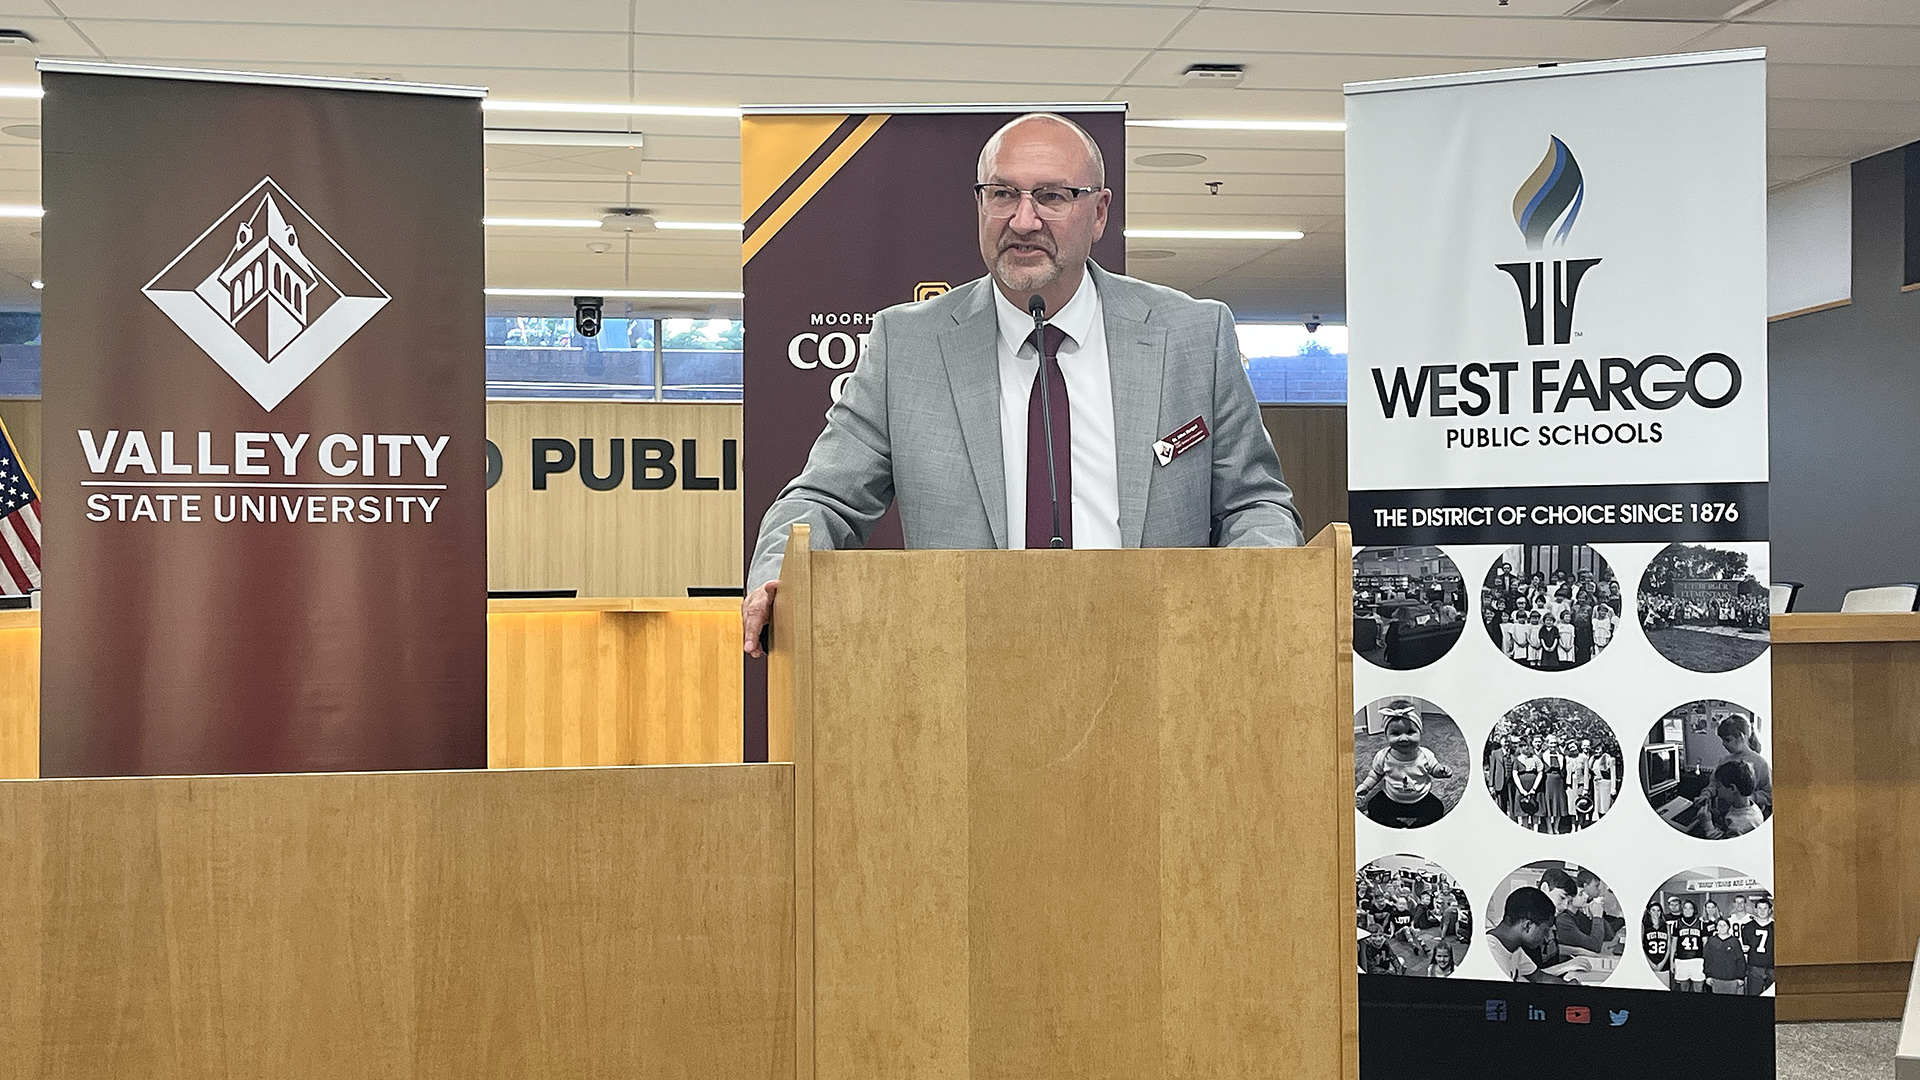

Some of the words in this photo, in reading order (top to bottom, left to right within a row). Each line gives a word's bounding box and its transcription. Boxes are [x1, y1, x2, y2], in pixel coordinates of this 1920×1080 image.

[810, 313, 876, 325] MOORH
[788, 332, 870, 369] CO
[1371, 362, 1519, 418] WEST
[1533, 352, 1742, 414] FARGO
[1447, 426, 1530, 448] PUBLIC
[1538, 422, 1663, 446] SCHOOLS
[77, 429, 310, 475] VALLEY
[318, 433, 451, 477] CITY
[532, 438, 743, 491] PUBLI
[86, 493, 201, 522] STATE
[214, 495, 441, 523] UNIVERSITY
[1374, 508, 1407, 527] THE
[1412, 507, 1494, 526] DISTRICT
[1498, 506, 1527, 525] OF
[1531, 504, 1616, 524] CHOICE
[1619, 503, 1683, 523] SINCE
[1690, 502, 1739, 522] 1876
[1648, 941, 1666, 954] 32
[1681, 936, 1699, 951] 41
[1755, 929, 1769, 953] 7
